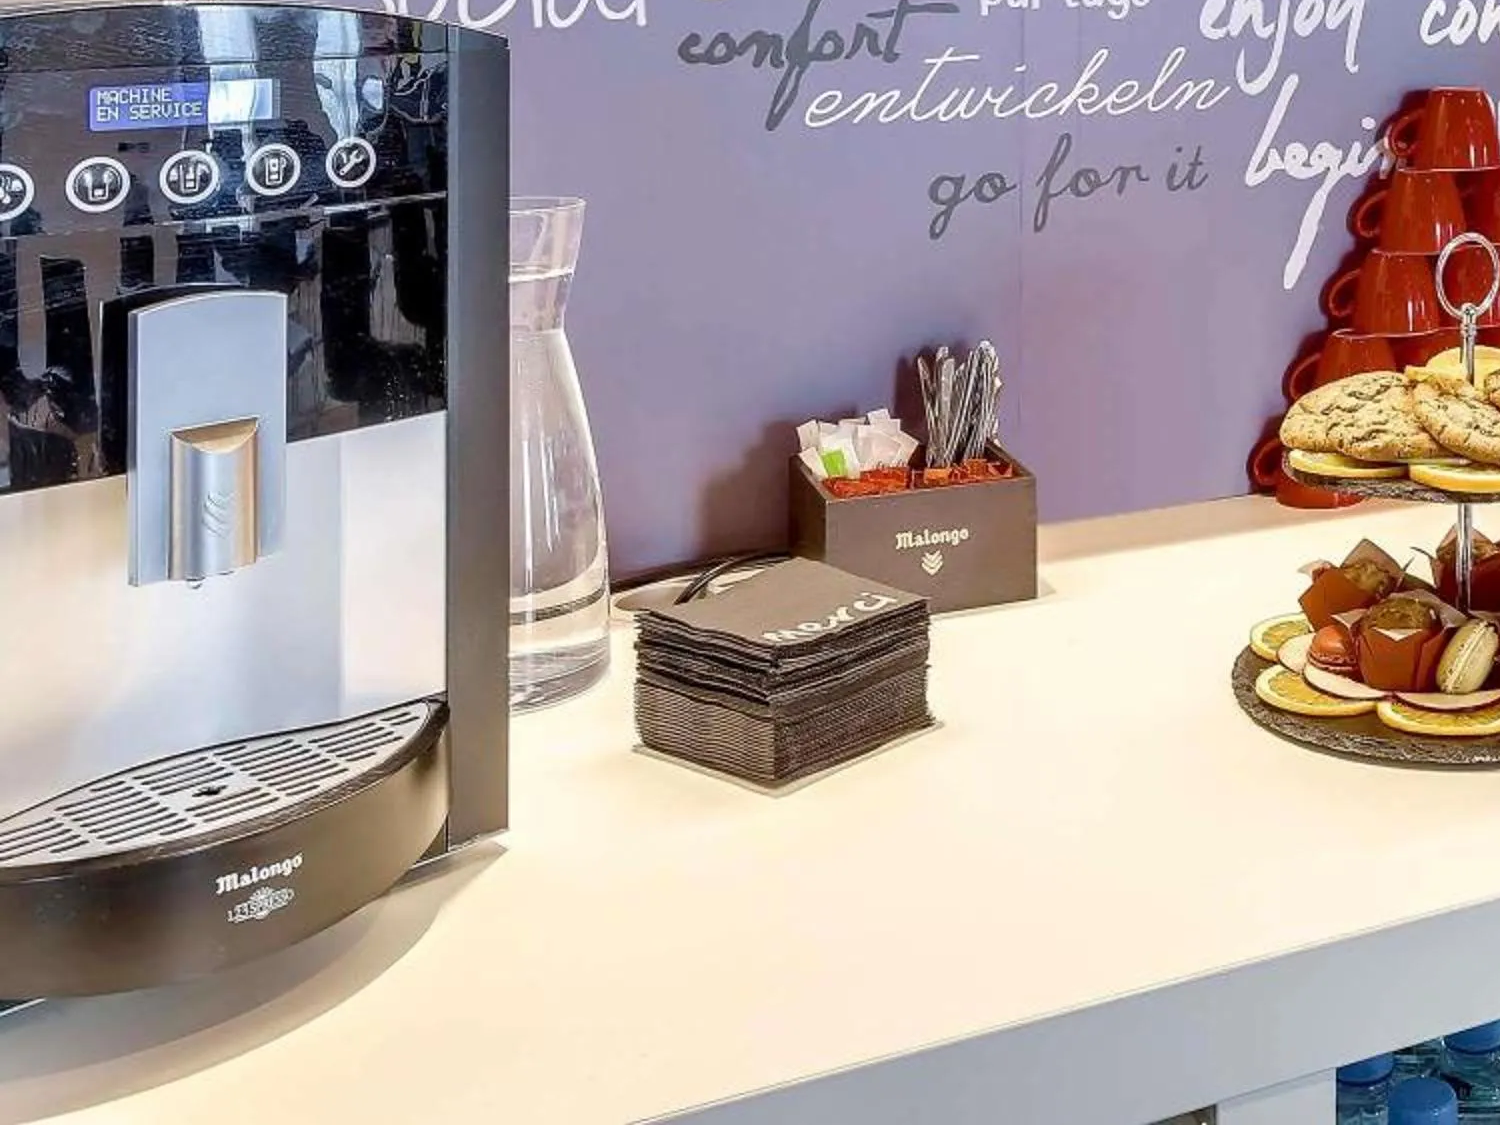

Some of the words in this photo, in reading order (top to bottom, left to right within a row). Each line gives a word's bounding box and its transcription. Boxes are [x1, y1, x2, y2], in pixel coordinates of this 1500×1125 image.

[96, 88, 172, 106] MACHINE
[804, 46, 1232, 128] entwickeln
[96, 106, 119, 122] EN
[129, 102, 203, 120] SERVICE
[928, 169, 1015, 239] go
[1033, 132, 1150, 233] for
[1166, 145, 1209, 191] it
[895, 527, 969, 550] Malongo
[215, 852, 304, 895] Malongo
